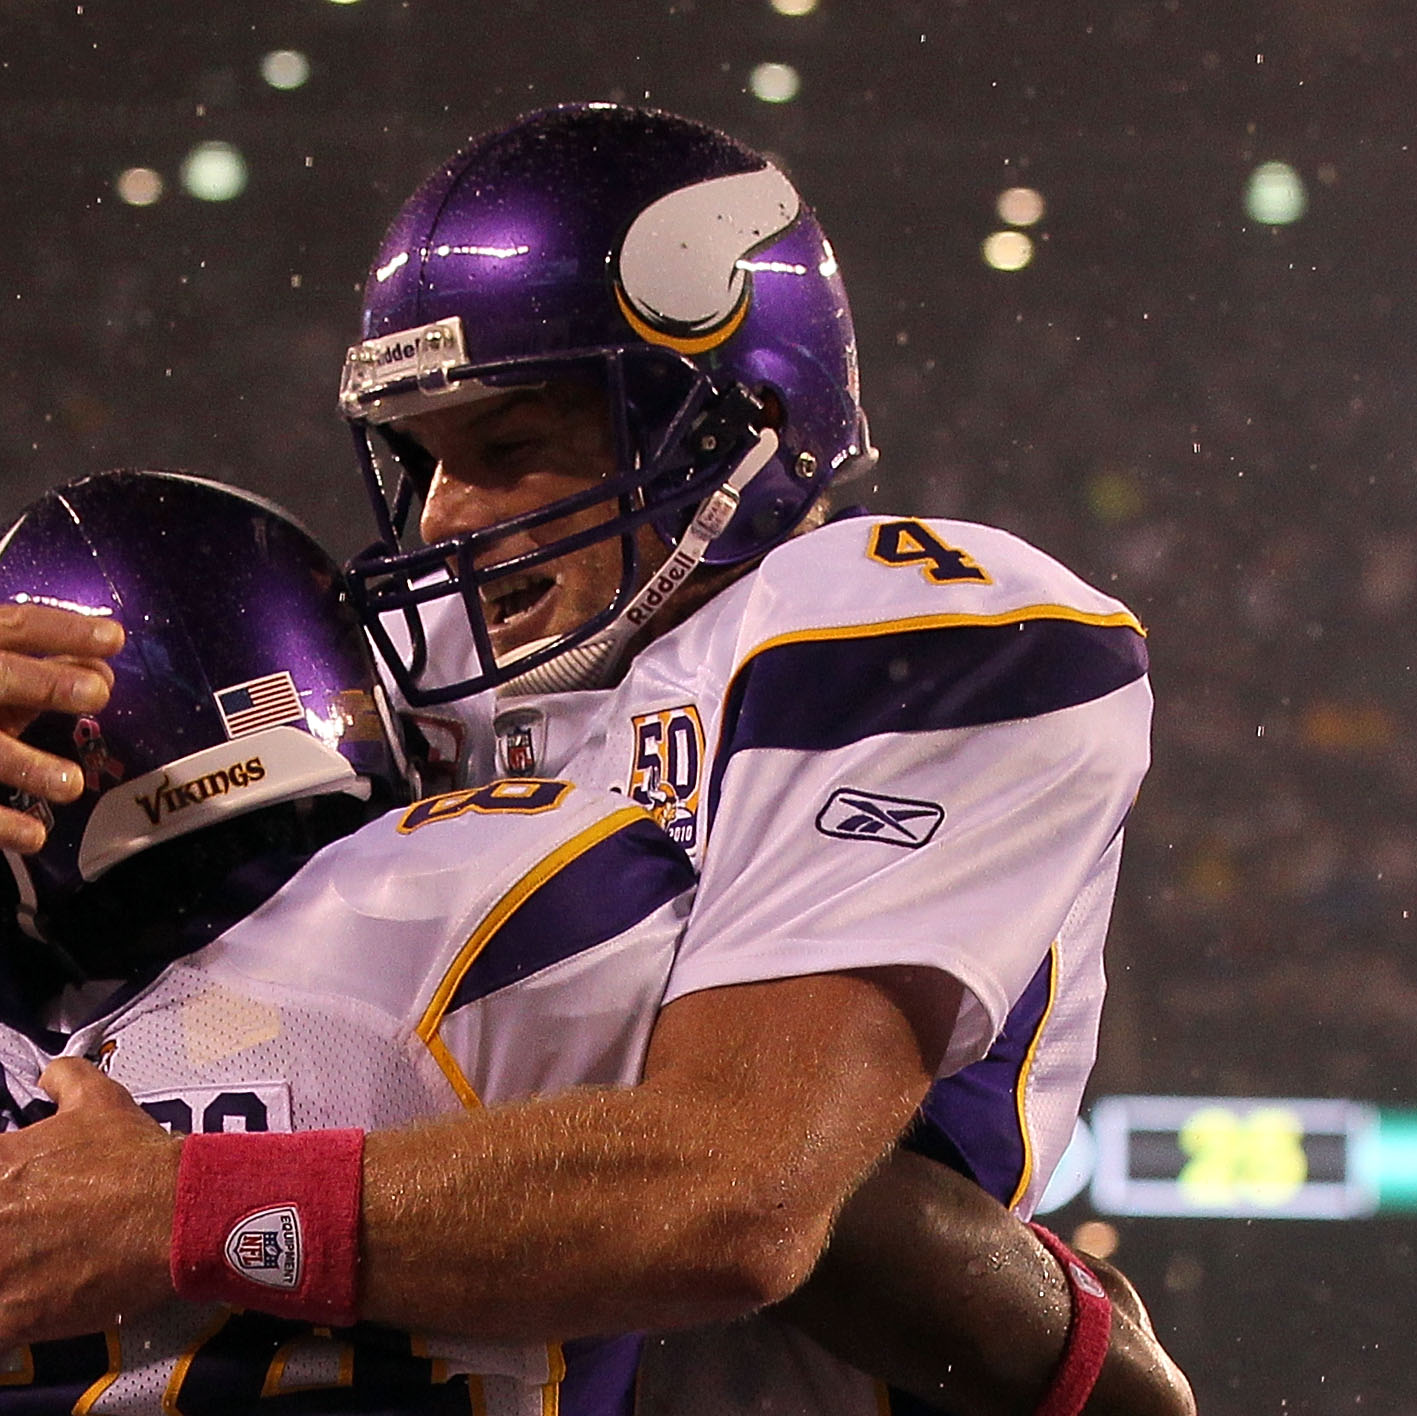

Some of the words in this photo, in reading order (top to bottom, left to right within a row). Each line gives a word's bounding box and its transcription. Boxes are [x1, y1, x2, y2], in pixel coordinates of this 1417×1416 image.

[865, 516, 992, 585] 4
[626, 551, 696, 626] Riddell
[632, 714, 700, 806] 50
[239, 1233, 264, 1266] NFL
[280, 1215, 296, 1284] EQUIPMENT
